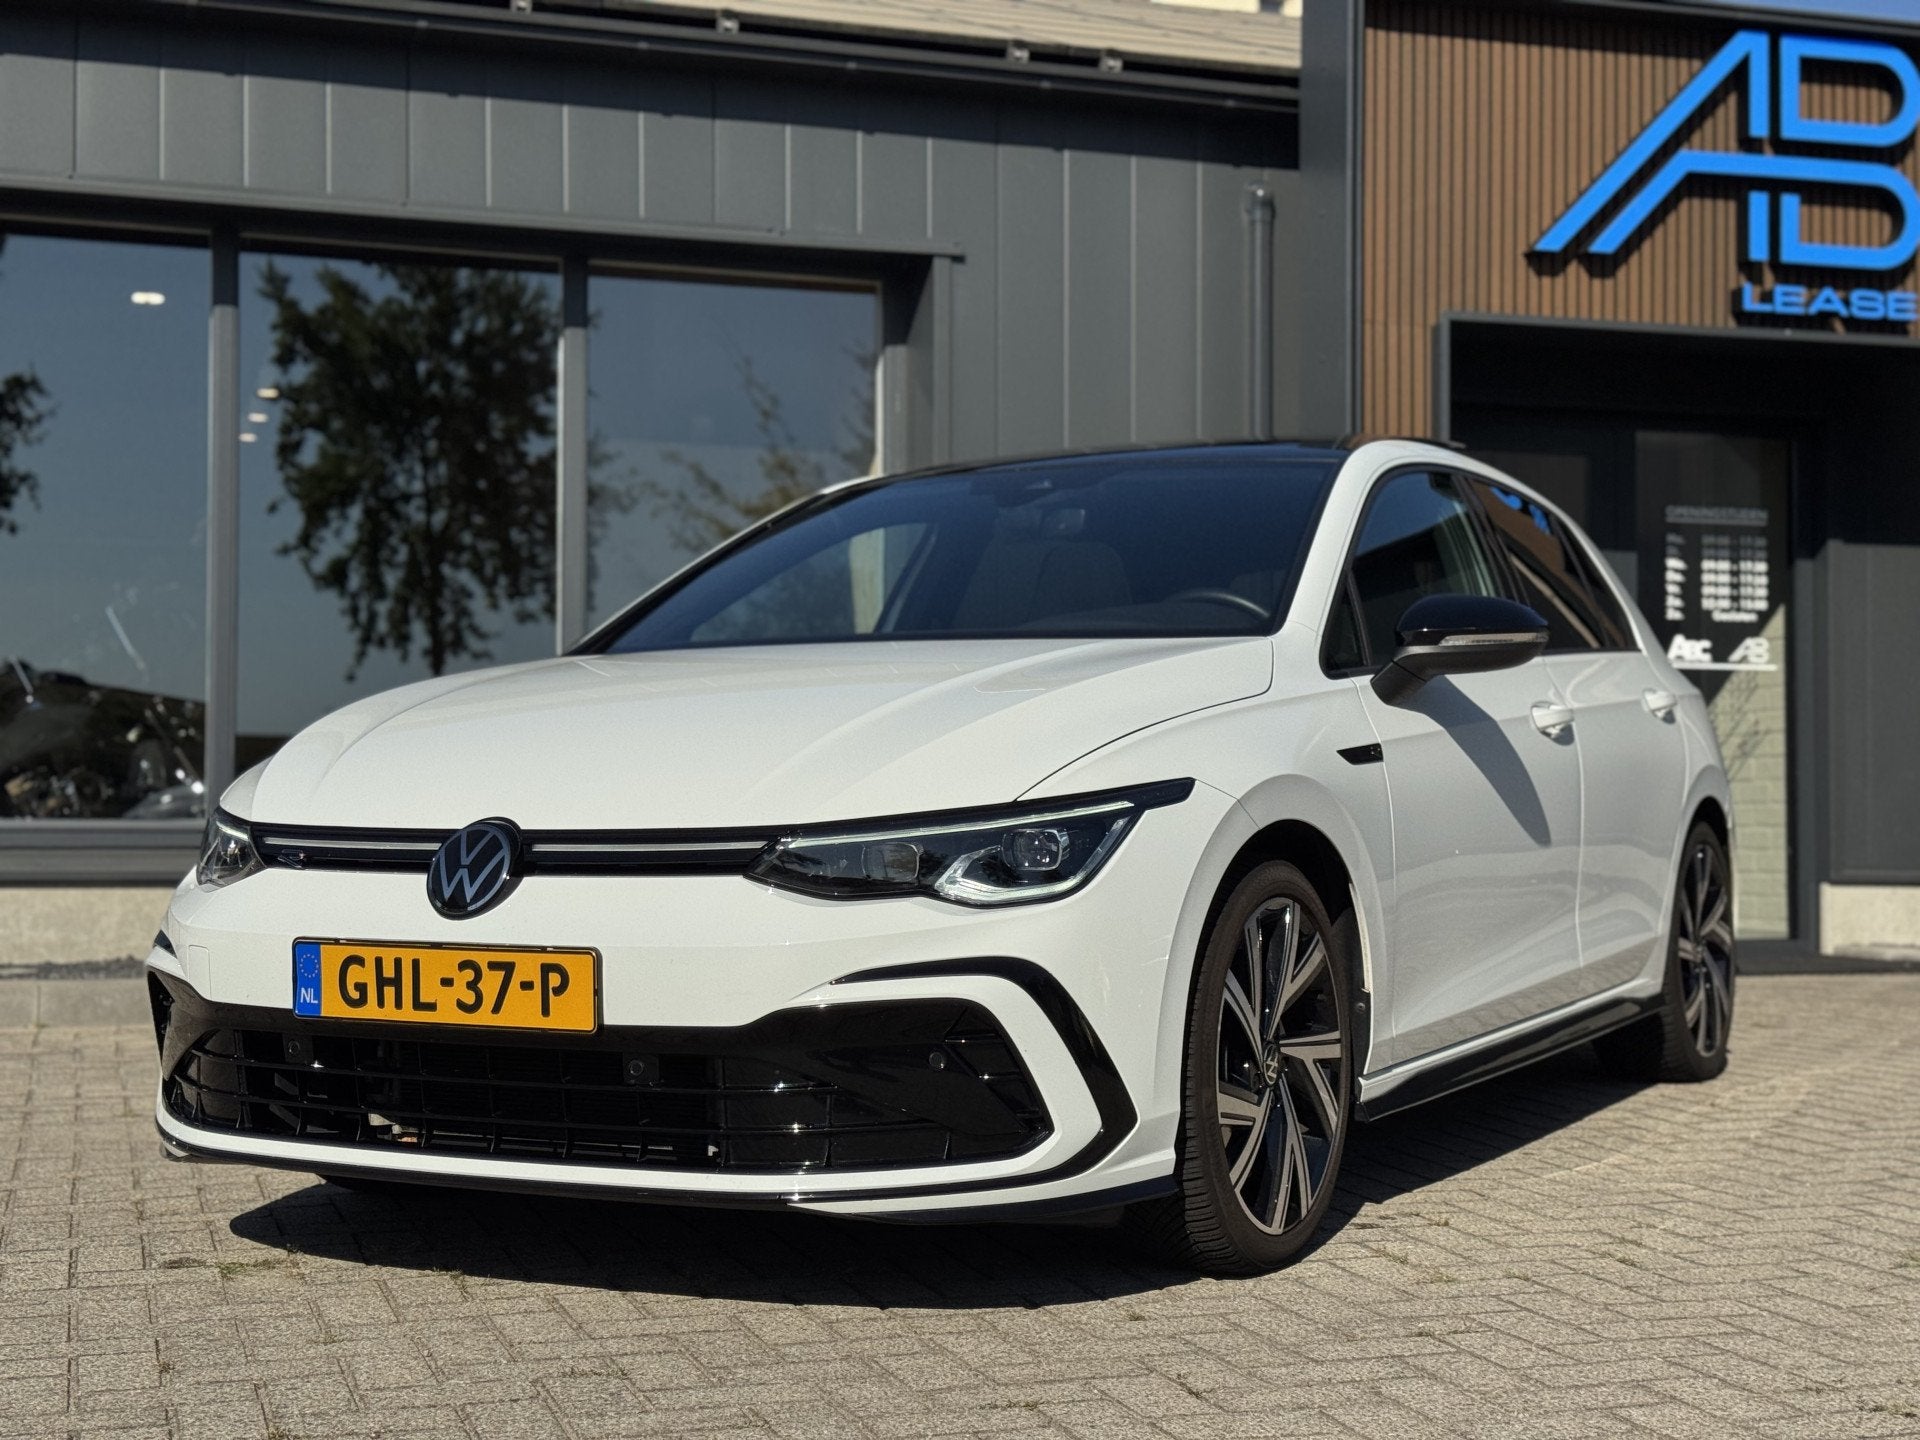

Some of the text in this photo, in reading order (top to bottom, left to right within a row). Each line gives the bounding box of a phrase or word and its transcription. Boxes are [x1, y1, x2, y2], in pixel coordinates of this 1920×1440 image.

[1533, 29, 1920, 271] AB
[1742, 281, 1918, 322] LEASE
[300, 987, 319, 1004] NL
[338, 954, 570, 1018] GHL-37-P
